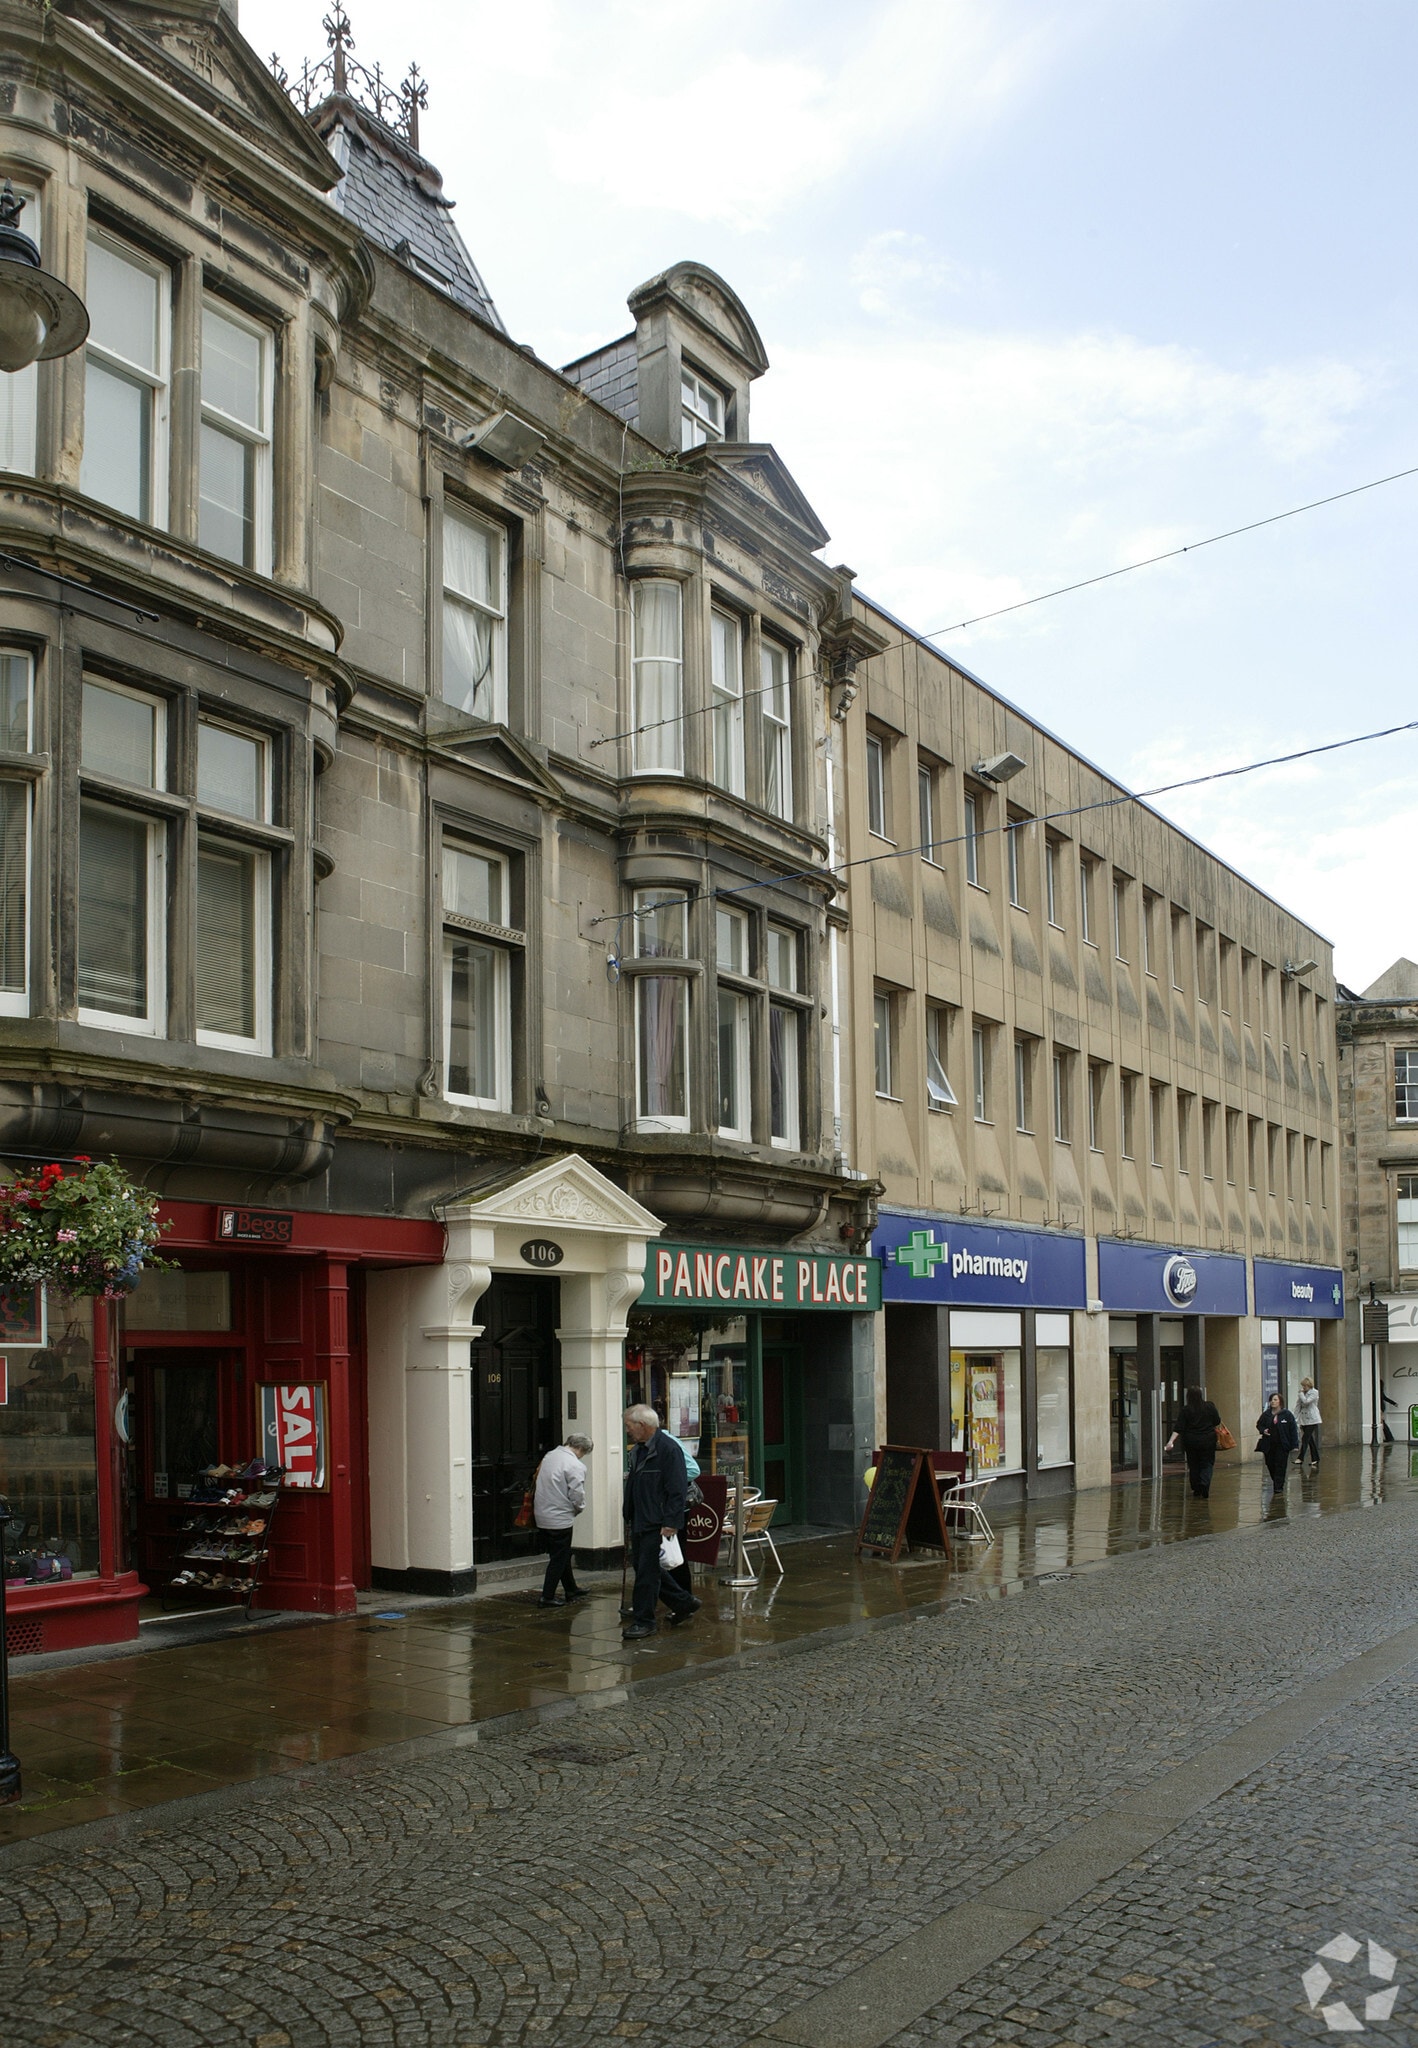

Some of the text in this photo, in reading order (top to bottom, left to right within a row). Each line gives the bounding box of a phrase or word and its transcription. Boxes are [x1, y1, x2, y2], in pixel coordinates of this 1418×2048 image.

[238, 1212, 290, 1241] Begg
[529, 1244, 556, 1262] 106
[657, 1249, 868, 1303] PANCAKE PLACE
[952, 1248, 1028, 1284] pharmacy
[1291, 1281, 1314, 1302] beauty
[487, 1373, 502, 1384] 106
[281, 1386, 313, 1488] SALE
[687, 1514, 713, 1528] ake
